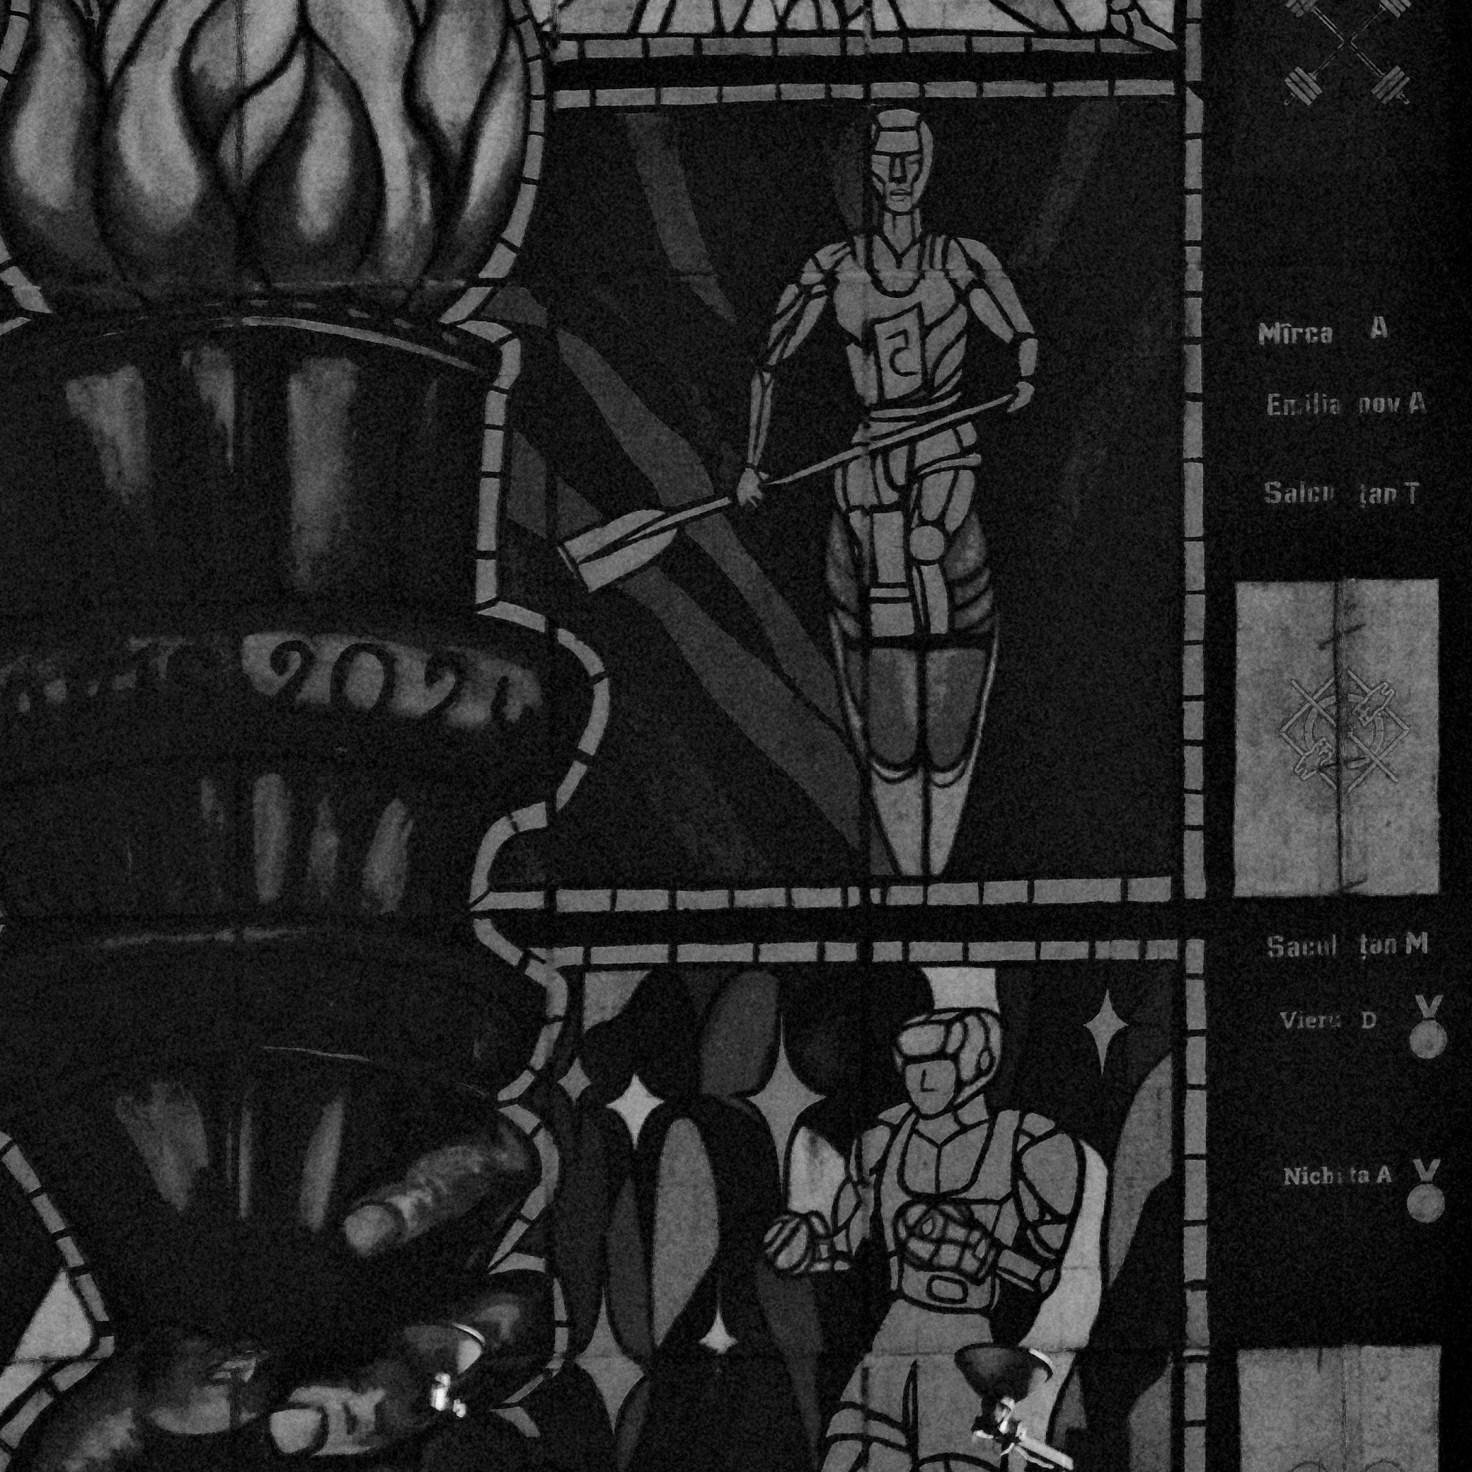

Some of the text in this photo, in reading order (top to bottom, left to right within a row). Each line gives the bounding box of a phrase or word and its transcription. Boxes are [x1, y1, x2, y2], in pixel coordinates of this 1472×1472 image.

[1370, 315, 1388, 339] A
[1408, 391, 1427, 415] A
[1404, 481, 1421, 505] T
[1405, 931, 1428, 955] M
[1362, 1011, 1377, 1030] D
[1376, 1164, 1393, 1184] A
